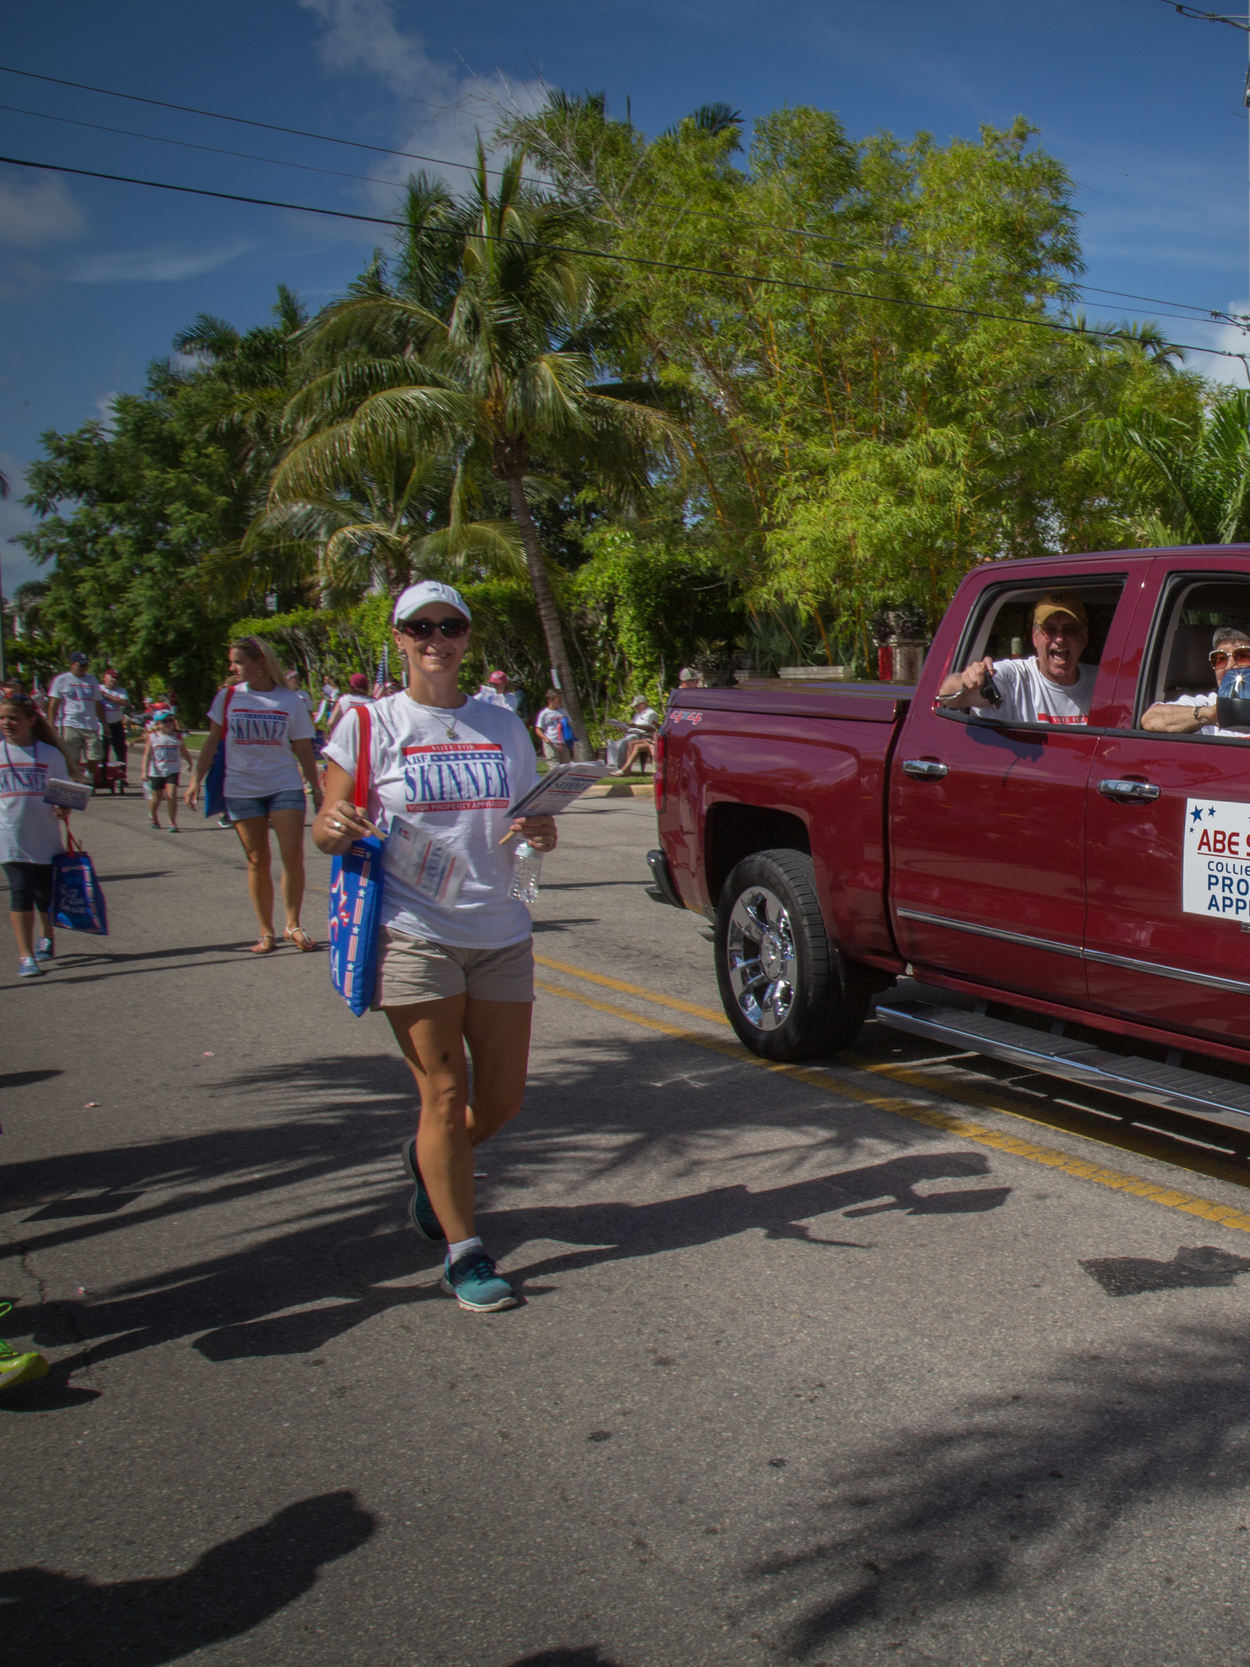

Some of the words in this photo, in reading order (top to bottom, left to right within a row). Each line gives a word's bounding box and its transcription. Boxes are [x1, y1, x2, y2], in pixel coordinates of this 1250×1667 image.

[404, 762, 510, 802] SKINNER
[408, 804, 430, 812] YOUR
[431, 802, 471, 811] PROPERTY
[1197, 829, 1240, 855] ABE
